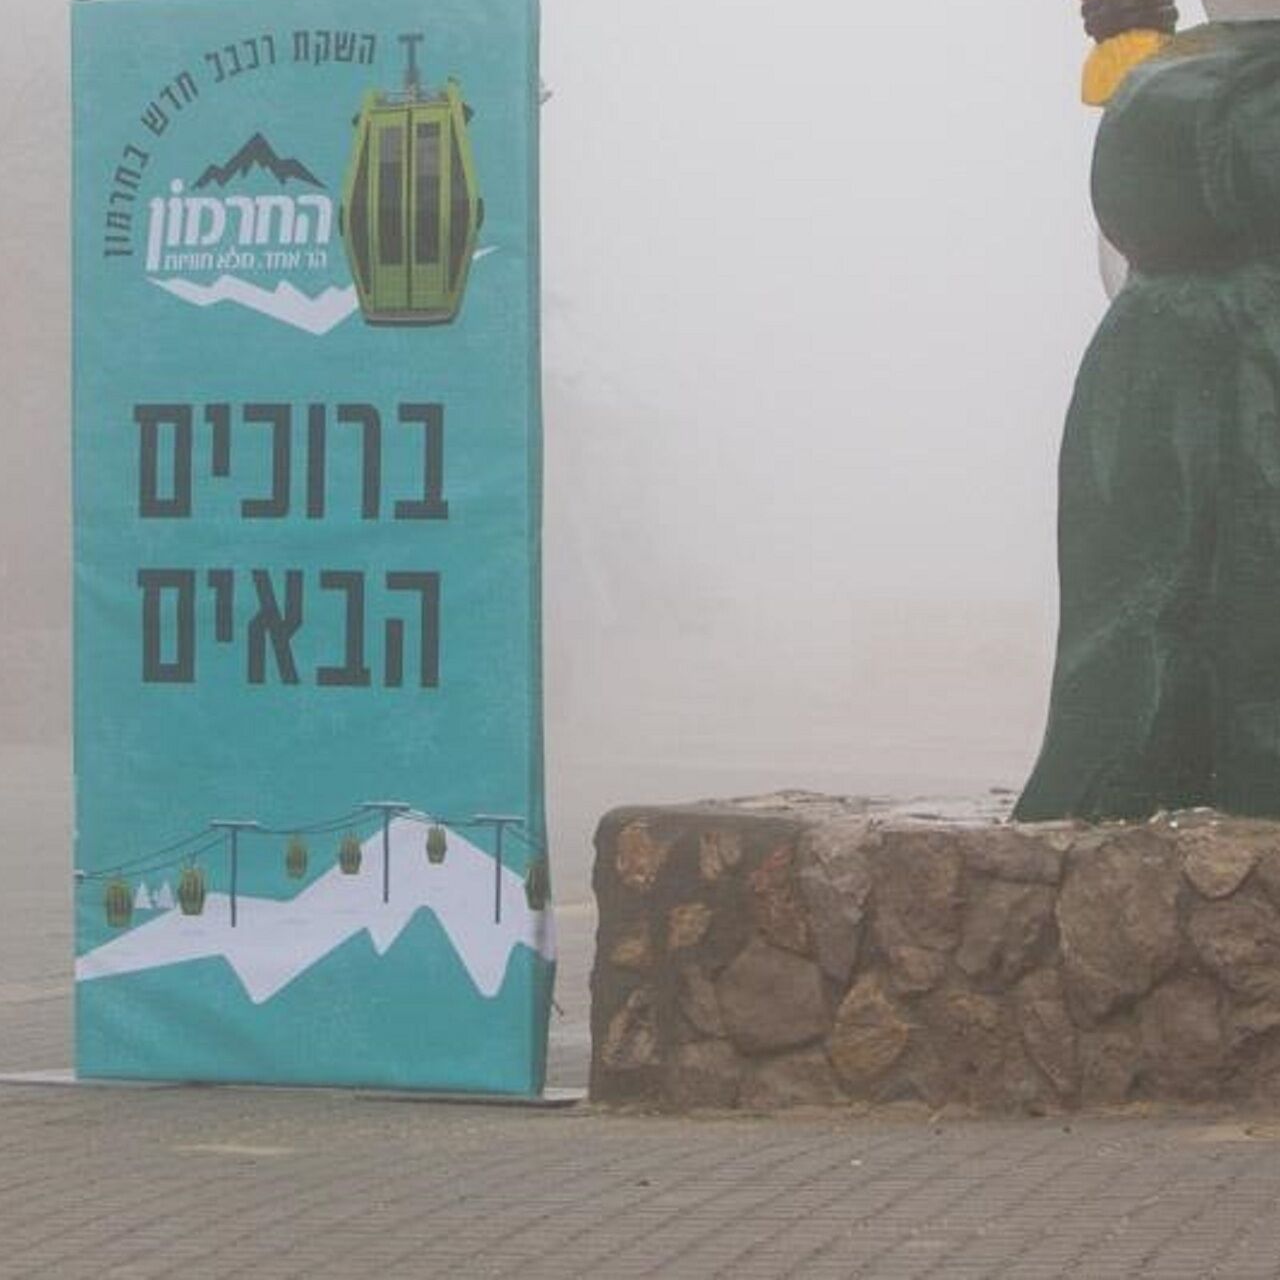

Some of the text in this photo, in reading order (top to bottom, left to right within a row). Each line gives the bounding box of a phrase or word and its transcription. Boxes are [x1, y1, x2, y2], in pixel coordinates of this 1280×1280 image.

[293, 30, 377, 67] השקת
[140, 70, 199, 137] חדש
[103, 143, 150, 258] בחרמון
[146, 178, 333, 272] החרמון
[217, 245, 255, 269] מלא
[304, 250, 328, 269] הר
[133, 403, 449, 520] ברוכים
[137, 568, 442, 688] הבאים
